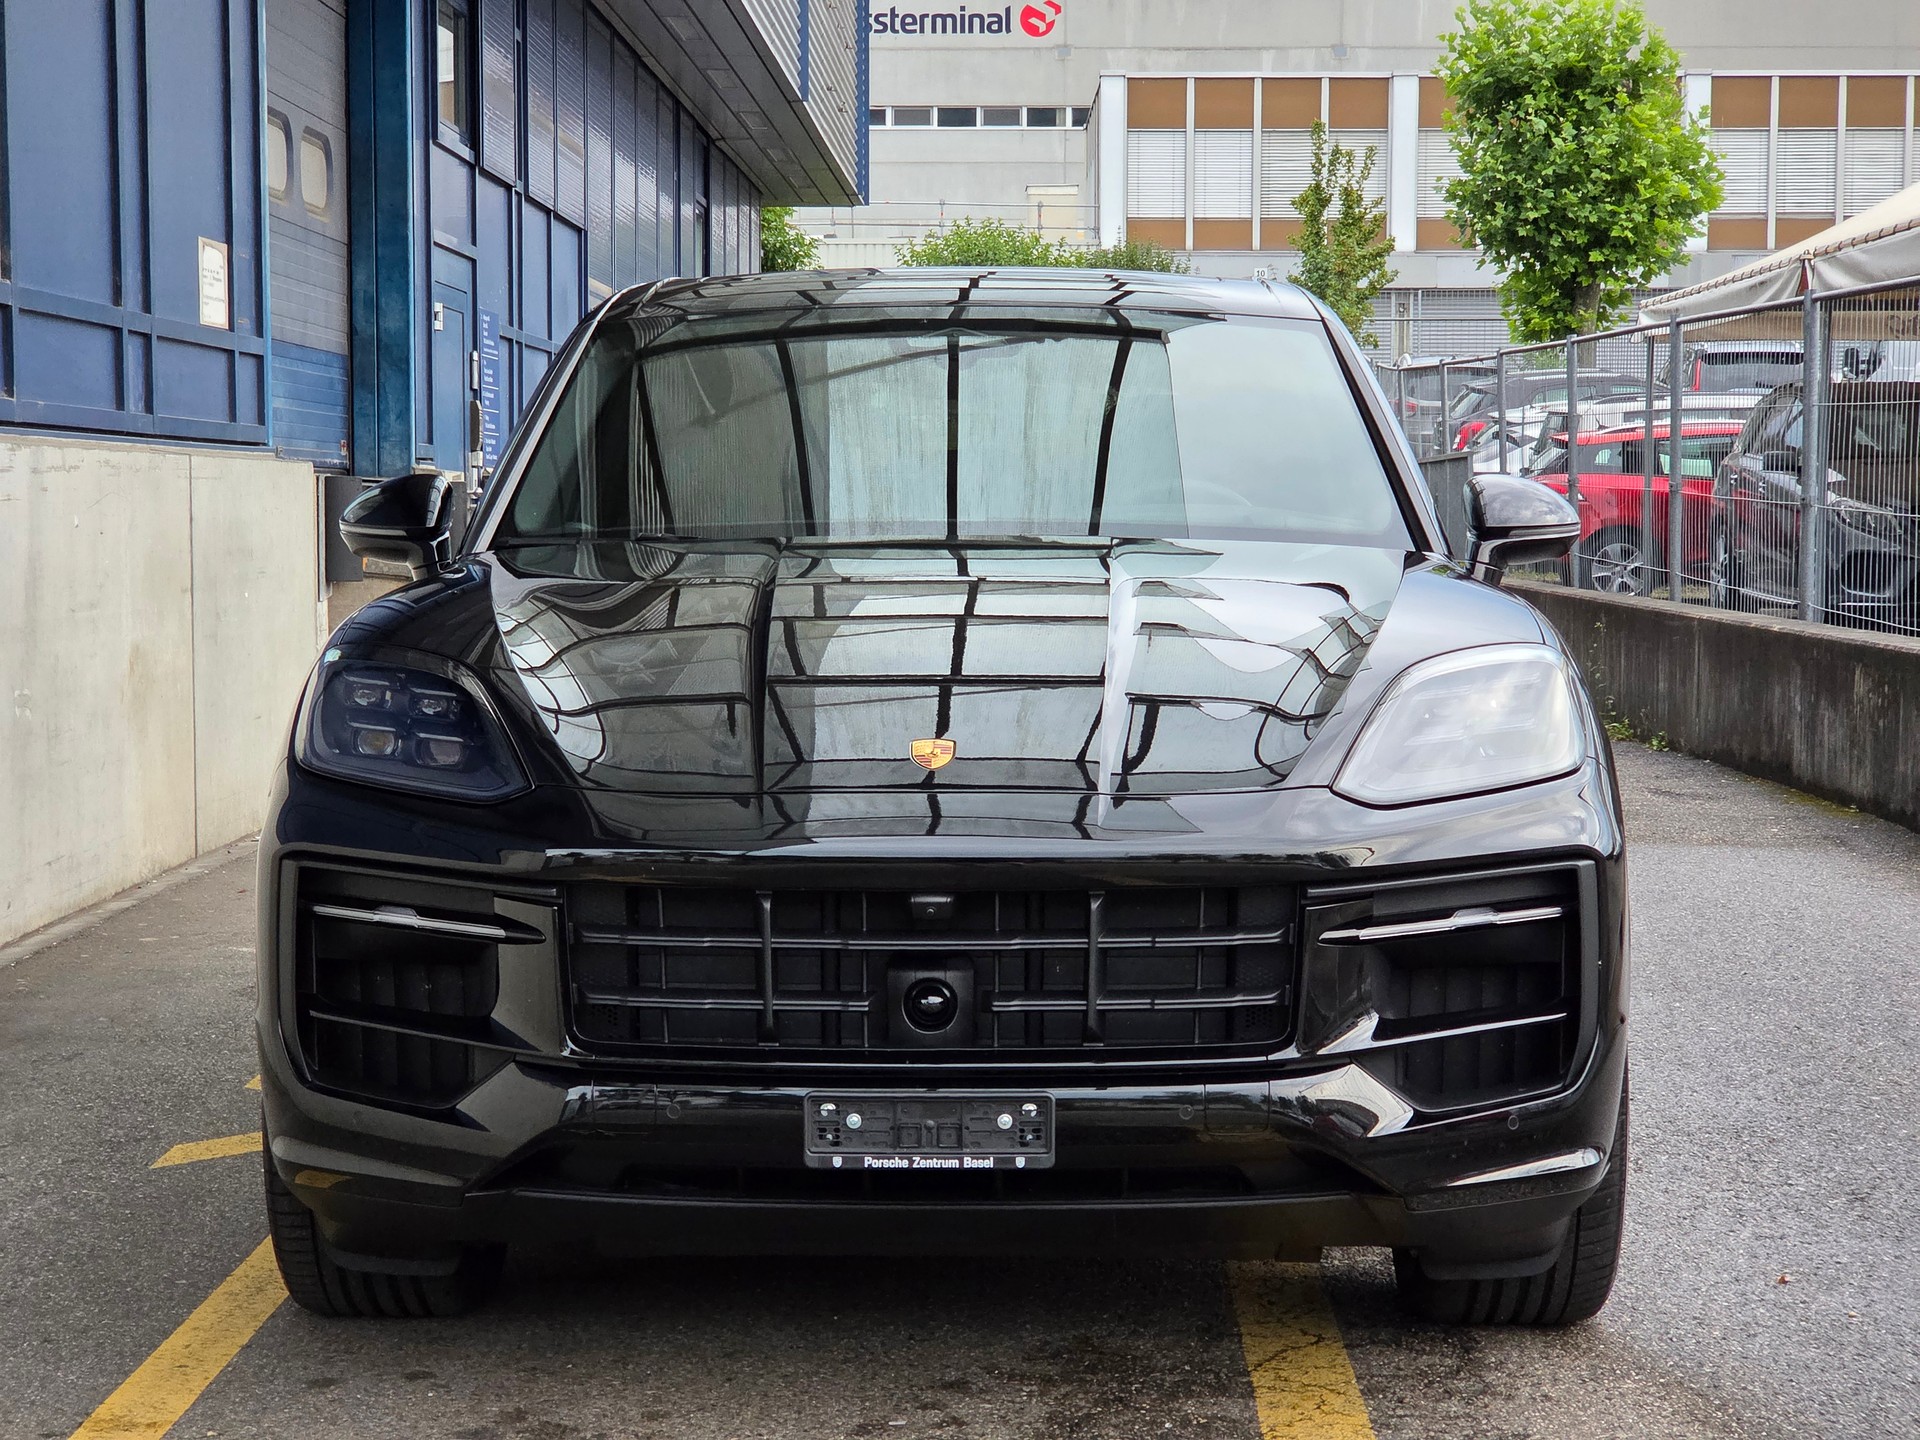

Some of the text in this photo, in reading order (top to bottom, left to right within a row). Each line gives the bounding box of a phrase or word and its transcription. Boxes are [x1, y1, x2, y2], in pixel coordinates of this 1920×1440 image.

[869, 5, 1012, 35] sterminal
[1256, 269, 1266, 277] 10
[864, 1156, 994, 1168] Porsche Zentrum Basel
